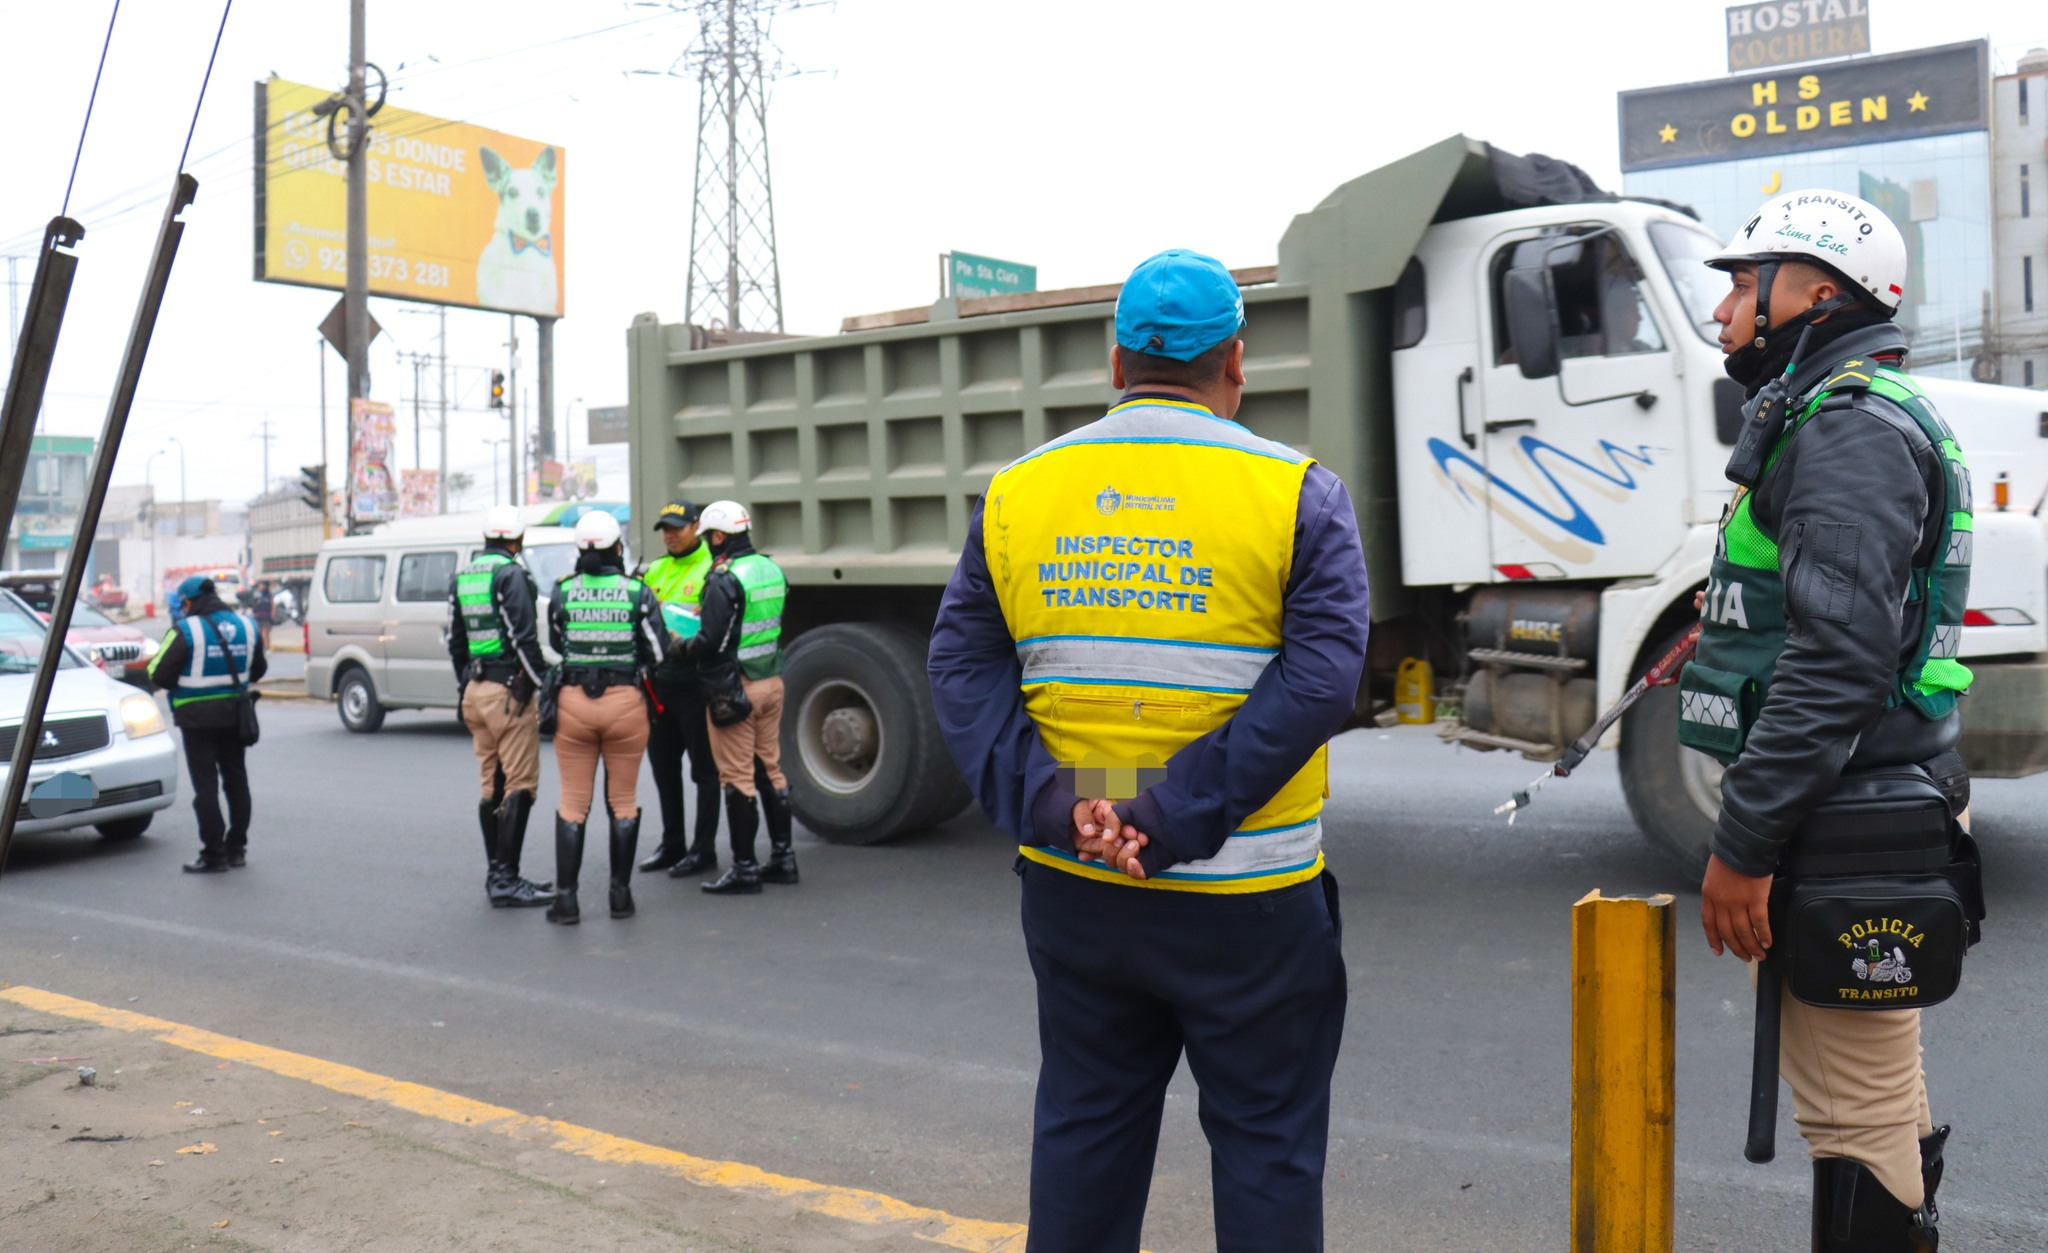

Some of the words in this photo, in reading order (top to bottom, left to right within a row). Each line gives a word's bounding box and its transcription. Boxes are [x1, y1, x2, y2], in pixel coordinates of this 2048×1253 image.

[1728, 0, 1867, 36] HOSTAL
[1730, 23, 1867, 68] COCHERA
[284, 141, 382, 183] QUIES
[386, 162, 451, 198] ESTAR
[394, 136, 467, 172] DONDE
[1782, 195, 1873, 235] TRANSITO
[1775, 223, 1811, 242] Lima
[1816, 234, 1849, 256] Este
[318, 246, 348, 273] 92
[367, 254, 409, 282] 373
[414, 260, 449, 288] 281
[1055, 535, 1194, 559] INSPECTOR
[1038, 561, 1173, 584] MUNICIPAL
[1180, 566, 1214, 587] DE
[567, 589, 630, 602] POLICIA
[1042, 587, 1208, 613] TRANSPORTE
[568, 608, 631, 622] TRANSITO
[1838, 917, 1926, 949] POLICIA
[1838, 986, 1919, 1000] TRANSITO
